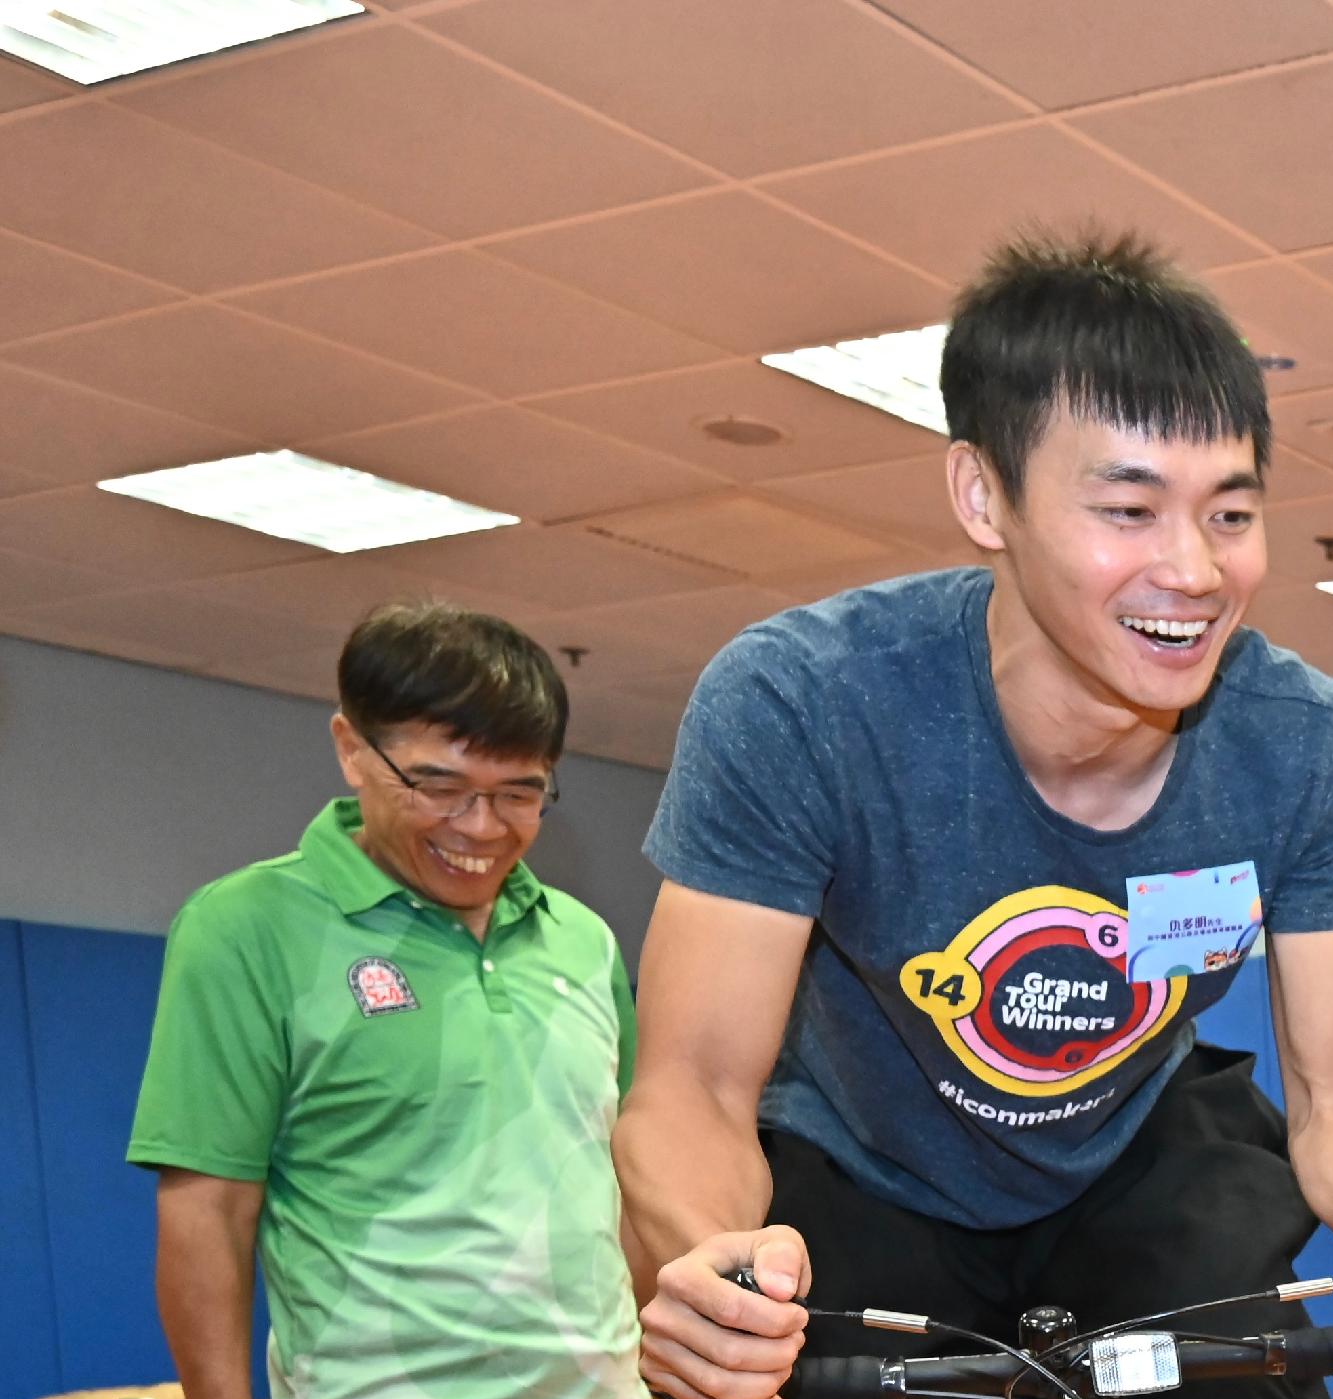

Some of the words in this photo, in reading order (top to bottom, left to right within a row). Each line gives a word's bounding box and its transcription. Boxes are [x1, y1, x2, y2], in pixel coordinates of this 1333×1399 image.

[1098, 924, 1119, 947] 6
[914, 968, 966, 1006] 14
[1005, 985, 1068, 1012] Tour
[1023, 972, 1108, 1001] Grand
[1002, 1004, 1115, 1031] Winners
